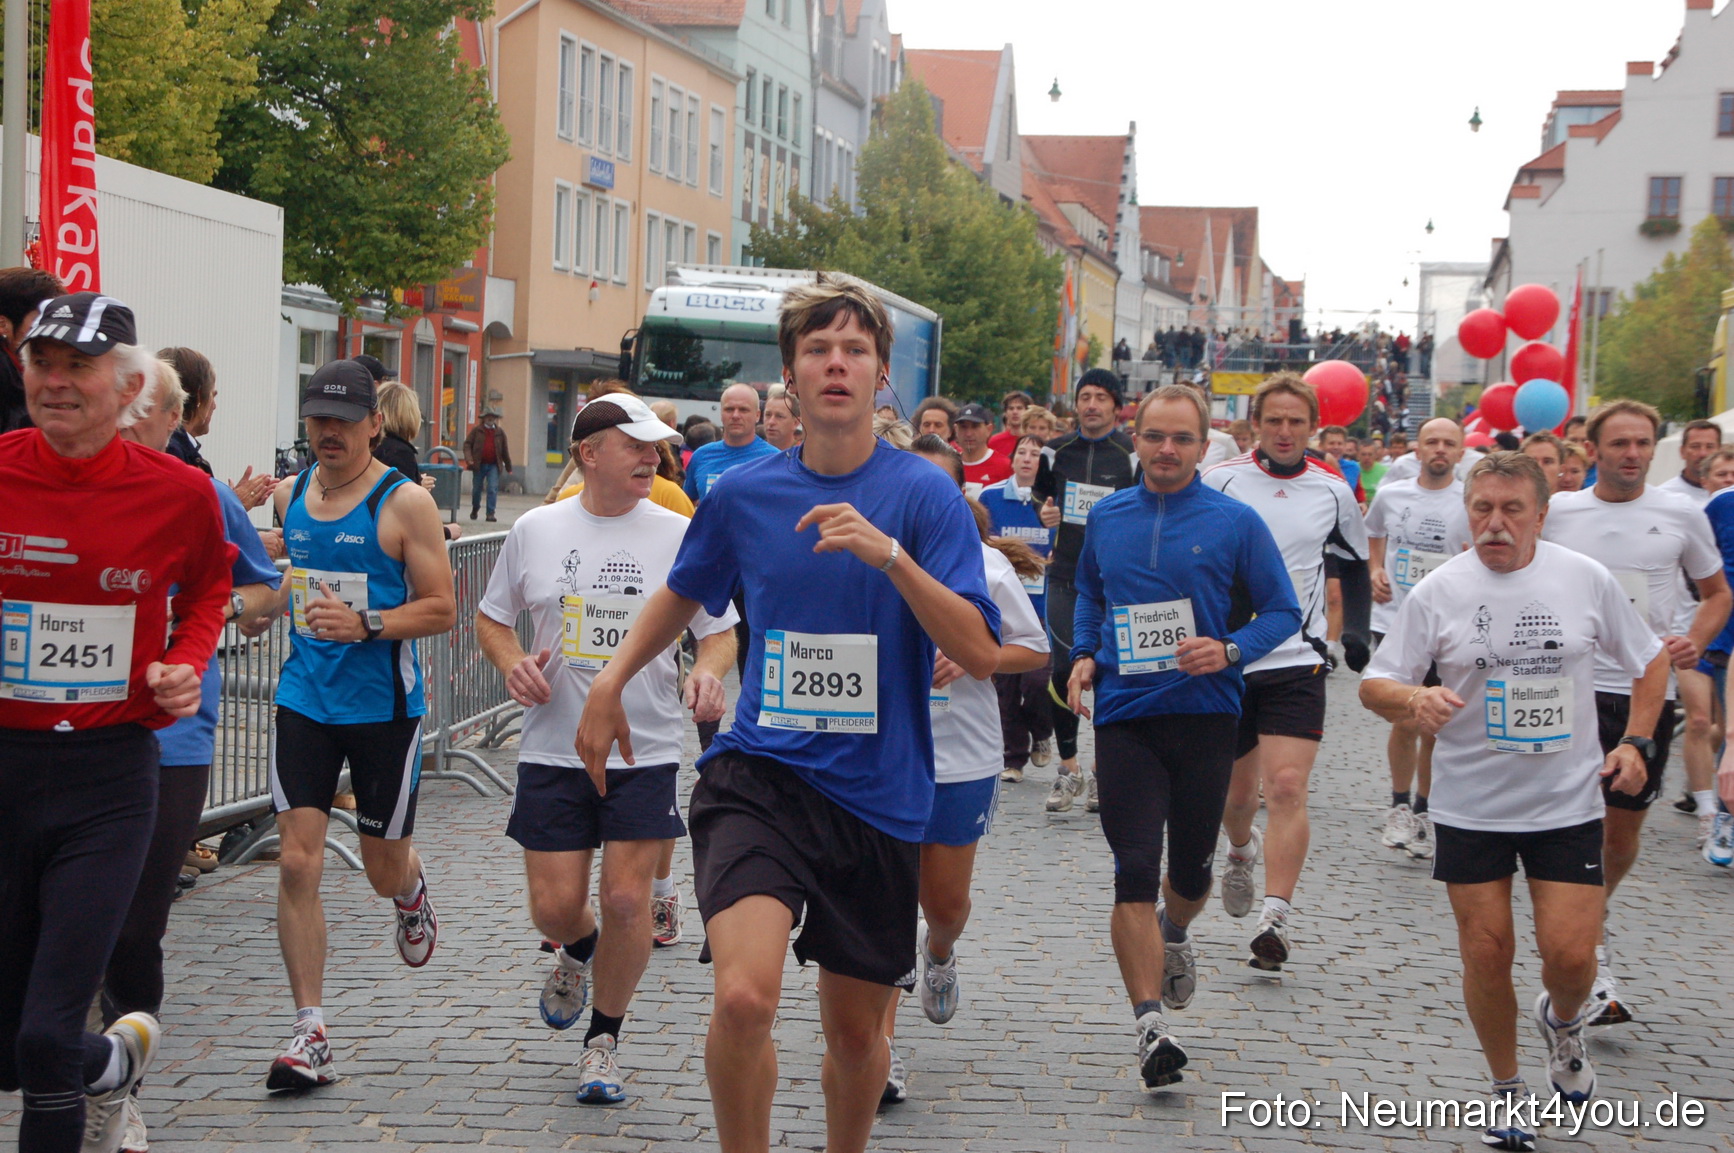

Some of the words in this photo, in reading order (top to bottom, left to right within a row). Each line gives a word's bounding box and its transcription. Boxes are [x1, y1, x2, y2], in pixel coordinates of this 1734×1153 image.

[686, 293, 765, 311] BOCK
[1078, 500, 1097, 510] 20
[1001, 526, 1050, 538] HUBER
[598, 575, 643, 584] 21.09.2008
[1411, 567, 1434, 579] 31
[309, 577, 341, 592] Rond
[586, 604, 629, 620] Werner
[1134, 608, 1179, 624] Friedrich
[40, 614, 85, 633] Horst
[592, 627, 629, 648] 30
[1138, 626, 1187, 649] 2286
[1513, 629, 1562, 638] 21.09.2008
[10, 638, 18, 651] B
[790, 640, 833, 660] Marco
[39, 643, 114, 668] 2451
[1496, 655, 1563, 668] Neumarkter
[768, 665, 775, 679] B
[1512, 664, 1562, 676] Stadtlauf
[791, 670, 863, 698] 2893
[1511, 686, 1560, 701] Hellmuth
[1491, 706, 1498, 716] C
[1513, 706, 1563, 728] 2521
[829, 717, 875, 727] PFLEIDERER
[360, 816, 383, 829] asics
